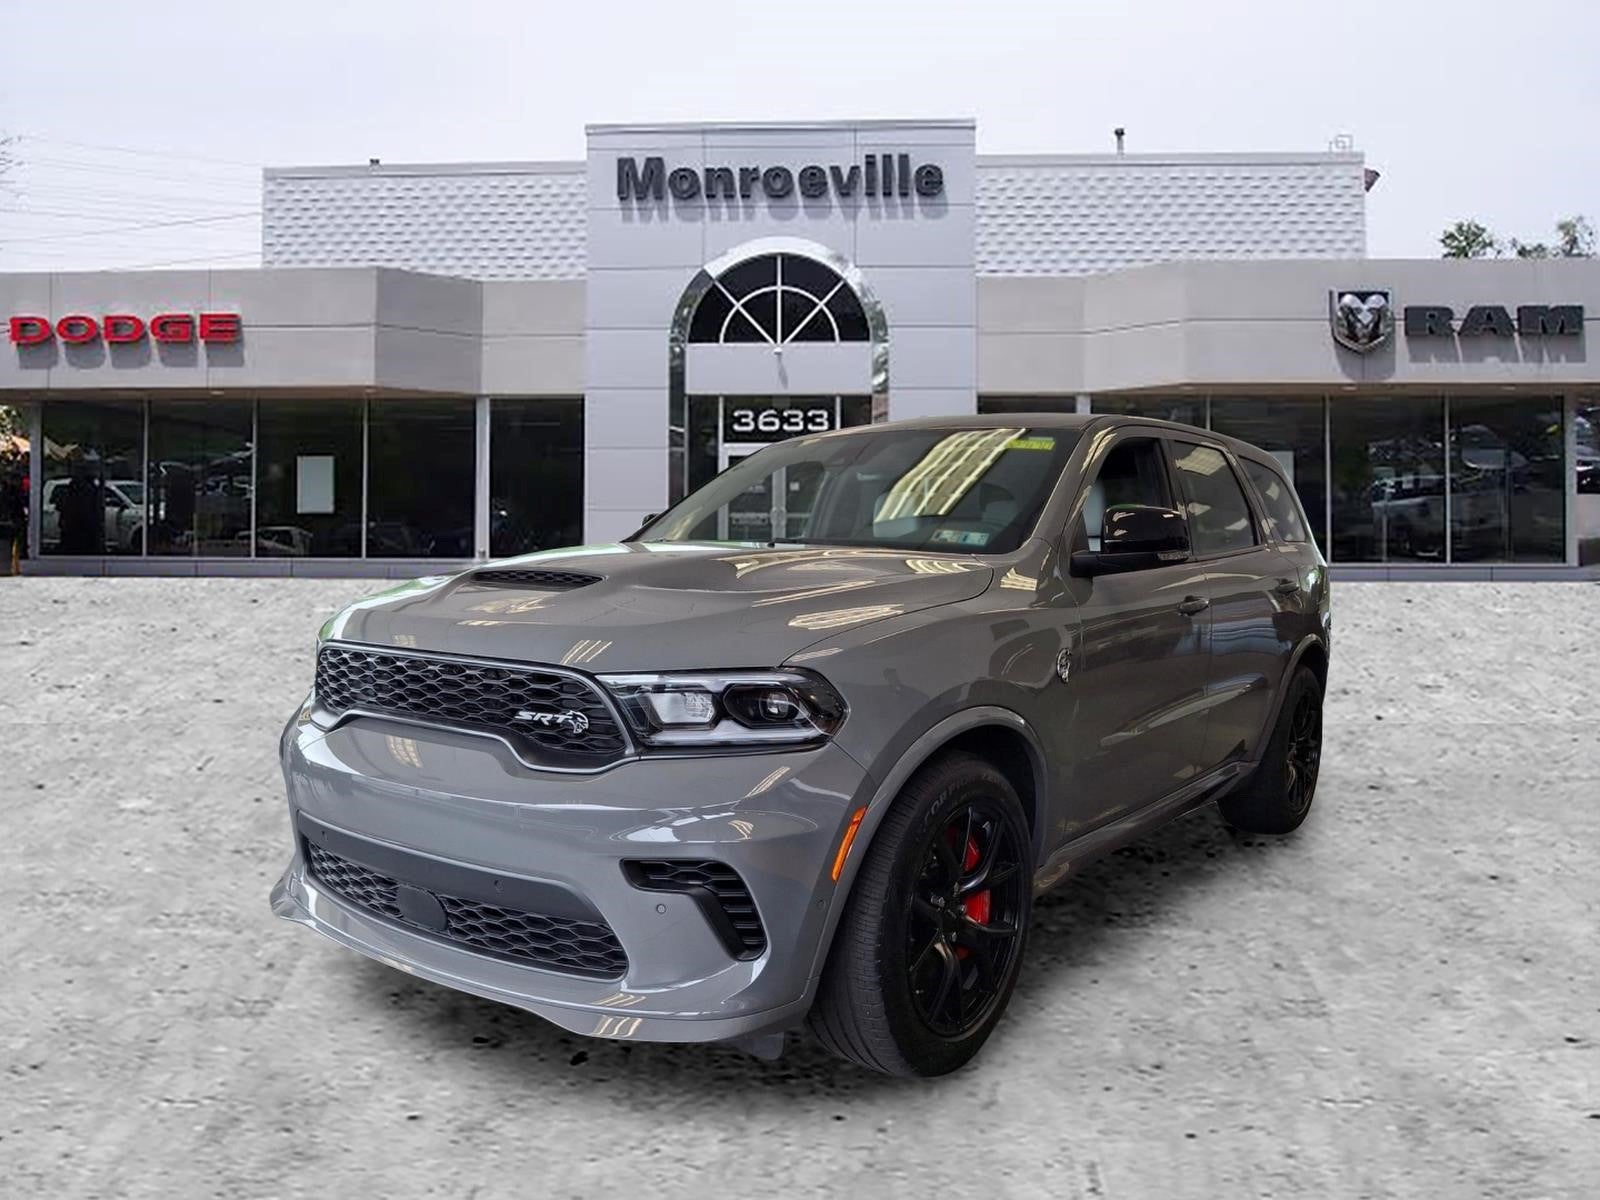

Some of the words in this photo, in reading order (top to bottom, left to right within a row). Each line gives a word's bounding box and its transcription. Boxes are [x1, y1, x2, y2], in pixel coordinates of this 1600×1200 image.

[616, 153, 944, 200] Monroeville
[9, 313, 243, 343] DODGE
[1403, 305, 1584, 336] RAM
[732, 409, 830, 432] 3633
[514, 710, 573, 726] SRT
